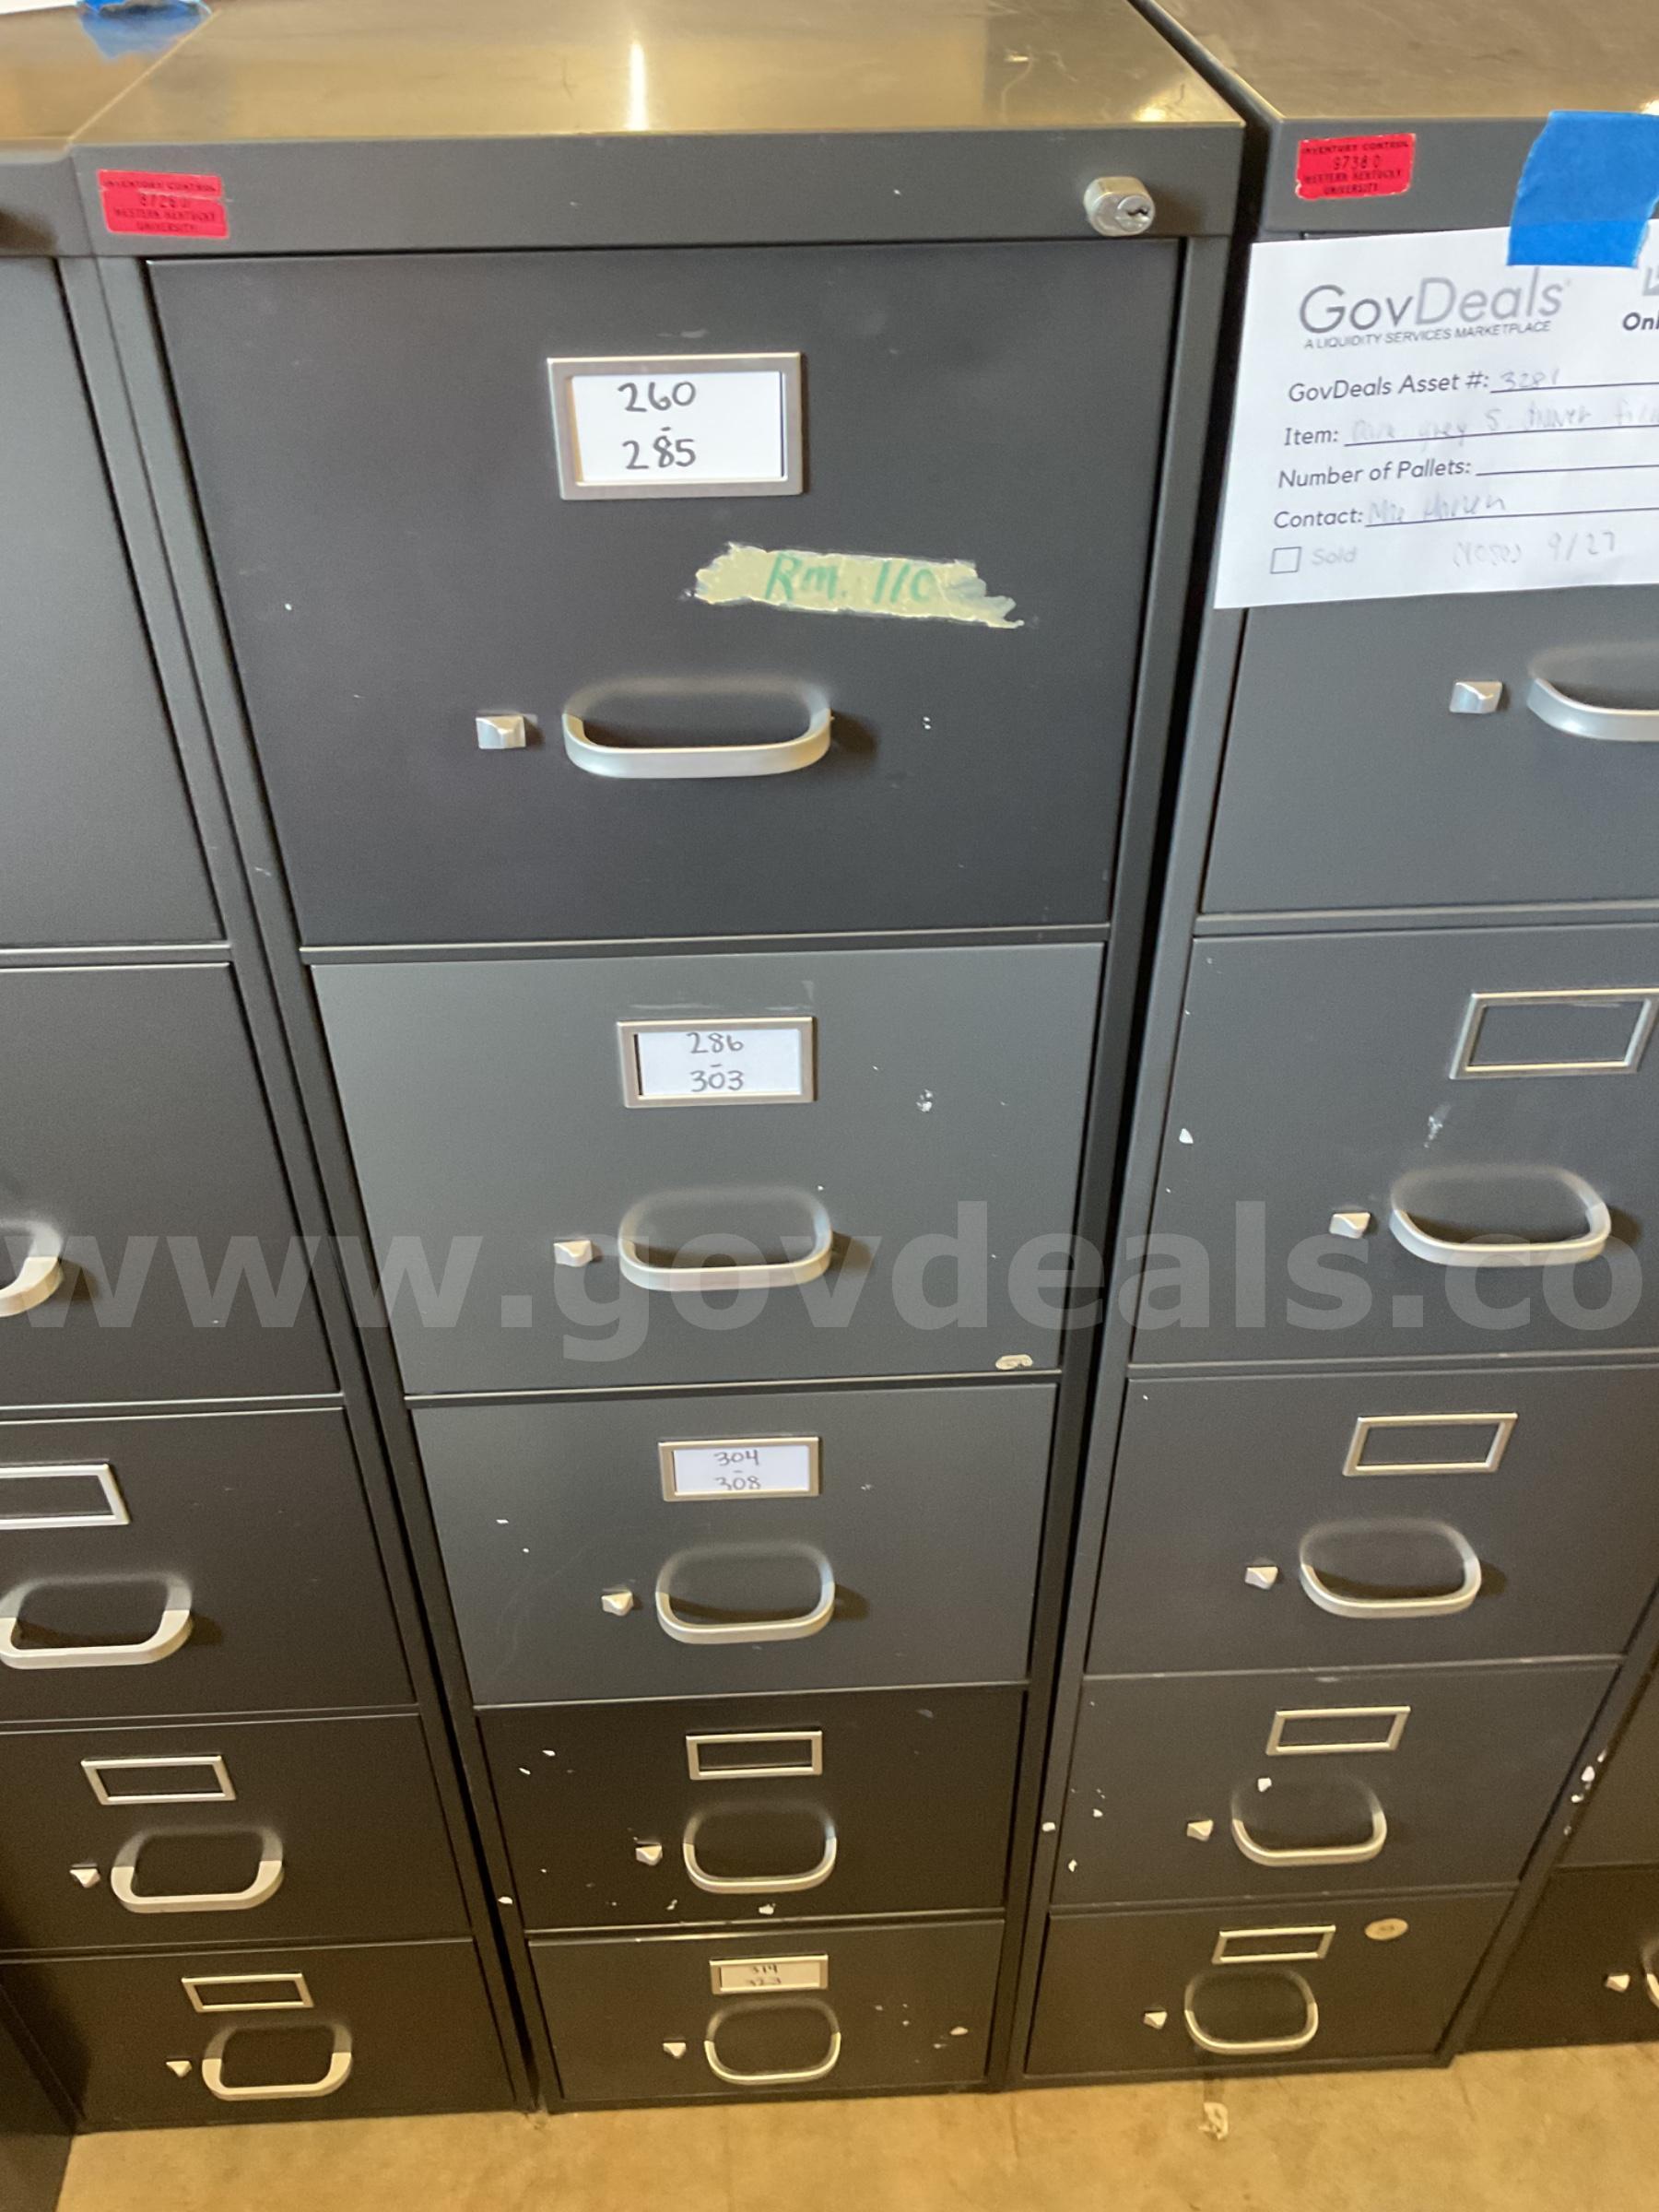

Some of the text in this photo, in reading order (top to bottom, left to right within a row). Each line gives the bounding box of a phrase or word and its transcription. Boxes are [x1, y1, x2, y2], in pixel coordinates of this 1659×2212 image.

[1299, 266, 1564, 334] GovDeals
[1304, 321, 1552, 349] A LIQUIDITY SERVICES MARKETPLACE
[617, 381, 698, 413] 260
[1288, 376, 1393, 402] GovDeals
[1397, 373, 1461, 394] Asset
[1283, 427, 1339, 446] Item:
[621, 436, 697, 471] 285
[1277, 458, 1472, 488] Number of Pallets:
[1273, 508, 1364, 529] Contact:
[1311, 546, 1359, 566] Sold
[686, 1031, 745, 1054] 286
[689, 1070, 745, 1093] 303
[713, 1449, 760, 1467] 304
[714, 1476, 762, 1491] 308
